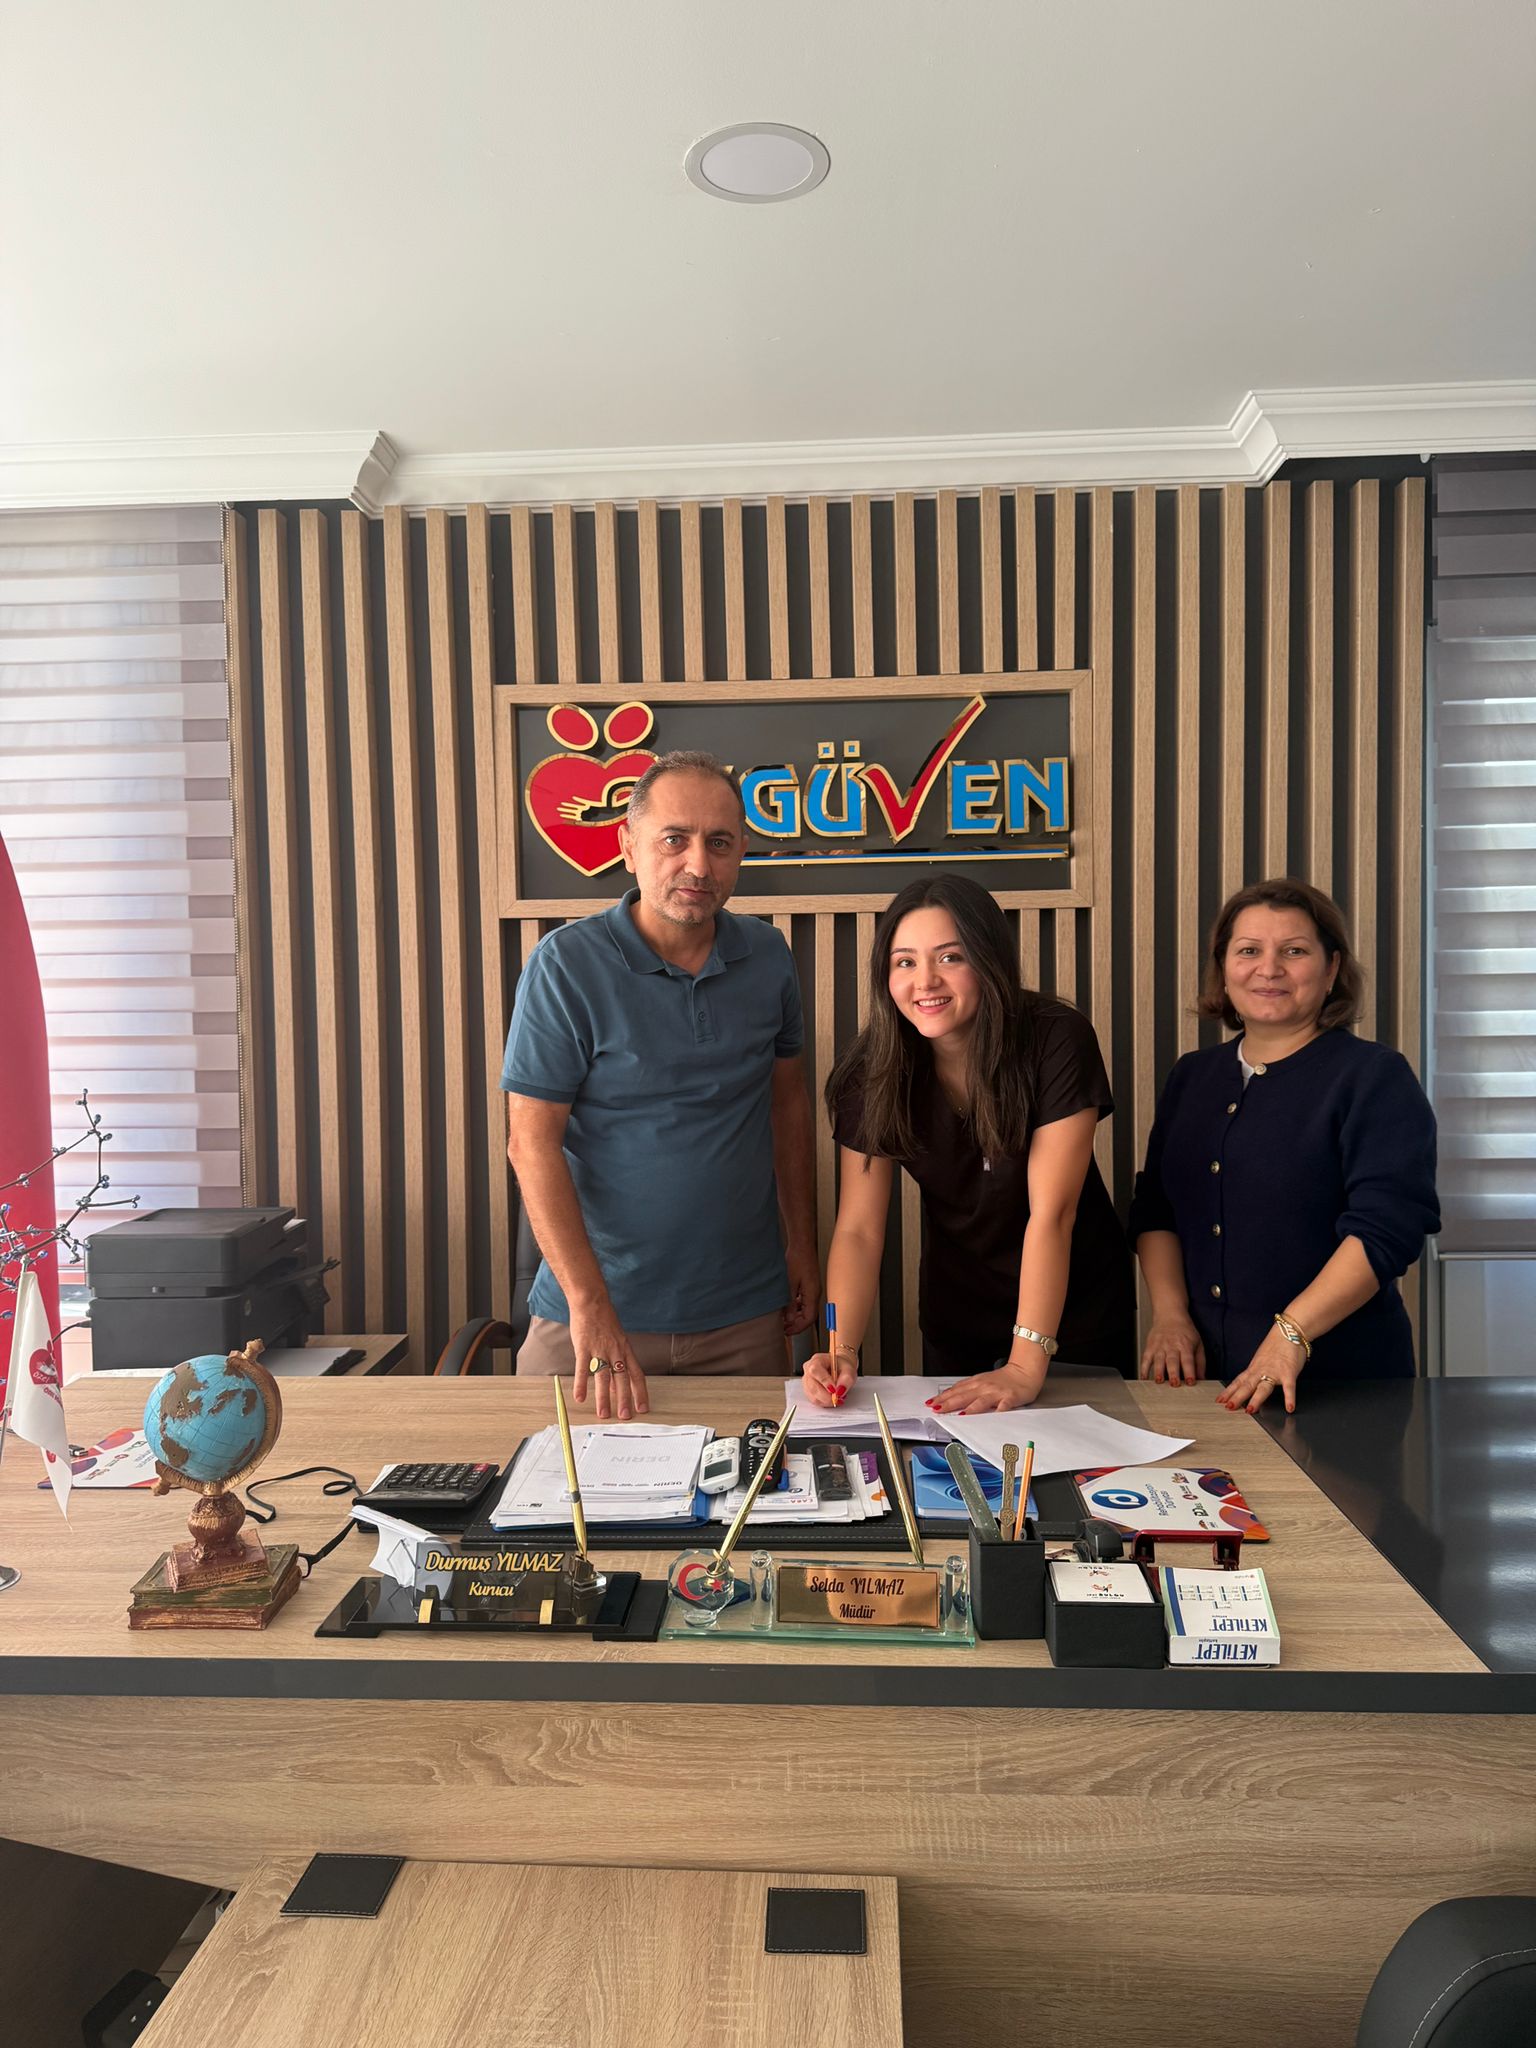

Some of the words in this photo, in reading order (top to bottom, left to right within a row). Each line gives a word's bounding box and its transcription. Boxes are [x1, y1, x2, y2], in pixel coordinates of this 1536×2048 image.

[724, 694, 1070, 846] GÜVEN
[425, 1551, 492, 1572] Durmuş
[496, 1552, 564, 1572] YILMAZ
[468, 1581, 515, 1597] Kurucu
[810, 1575, 845, 1593] Selda
[850, 1577, 905, 1597] YILMAZ
[839, 1603, 876, 1619] Müdür
